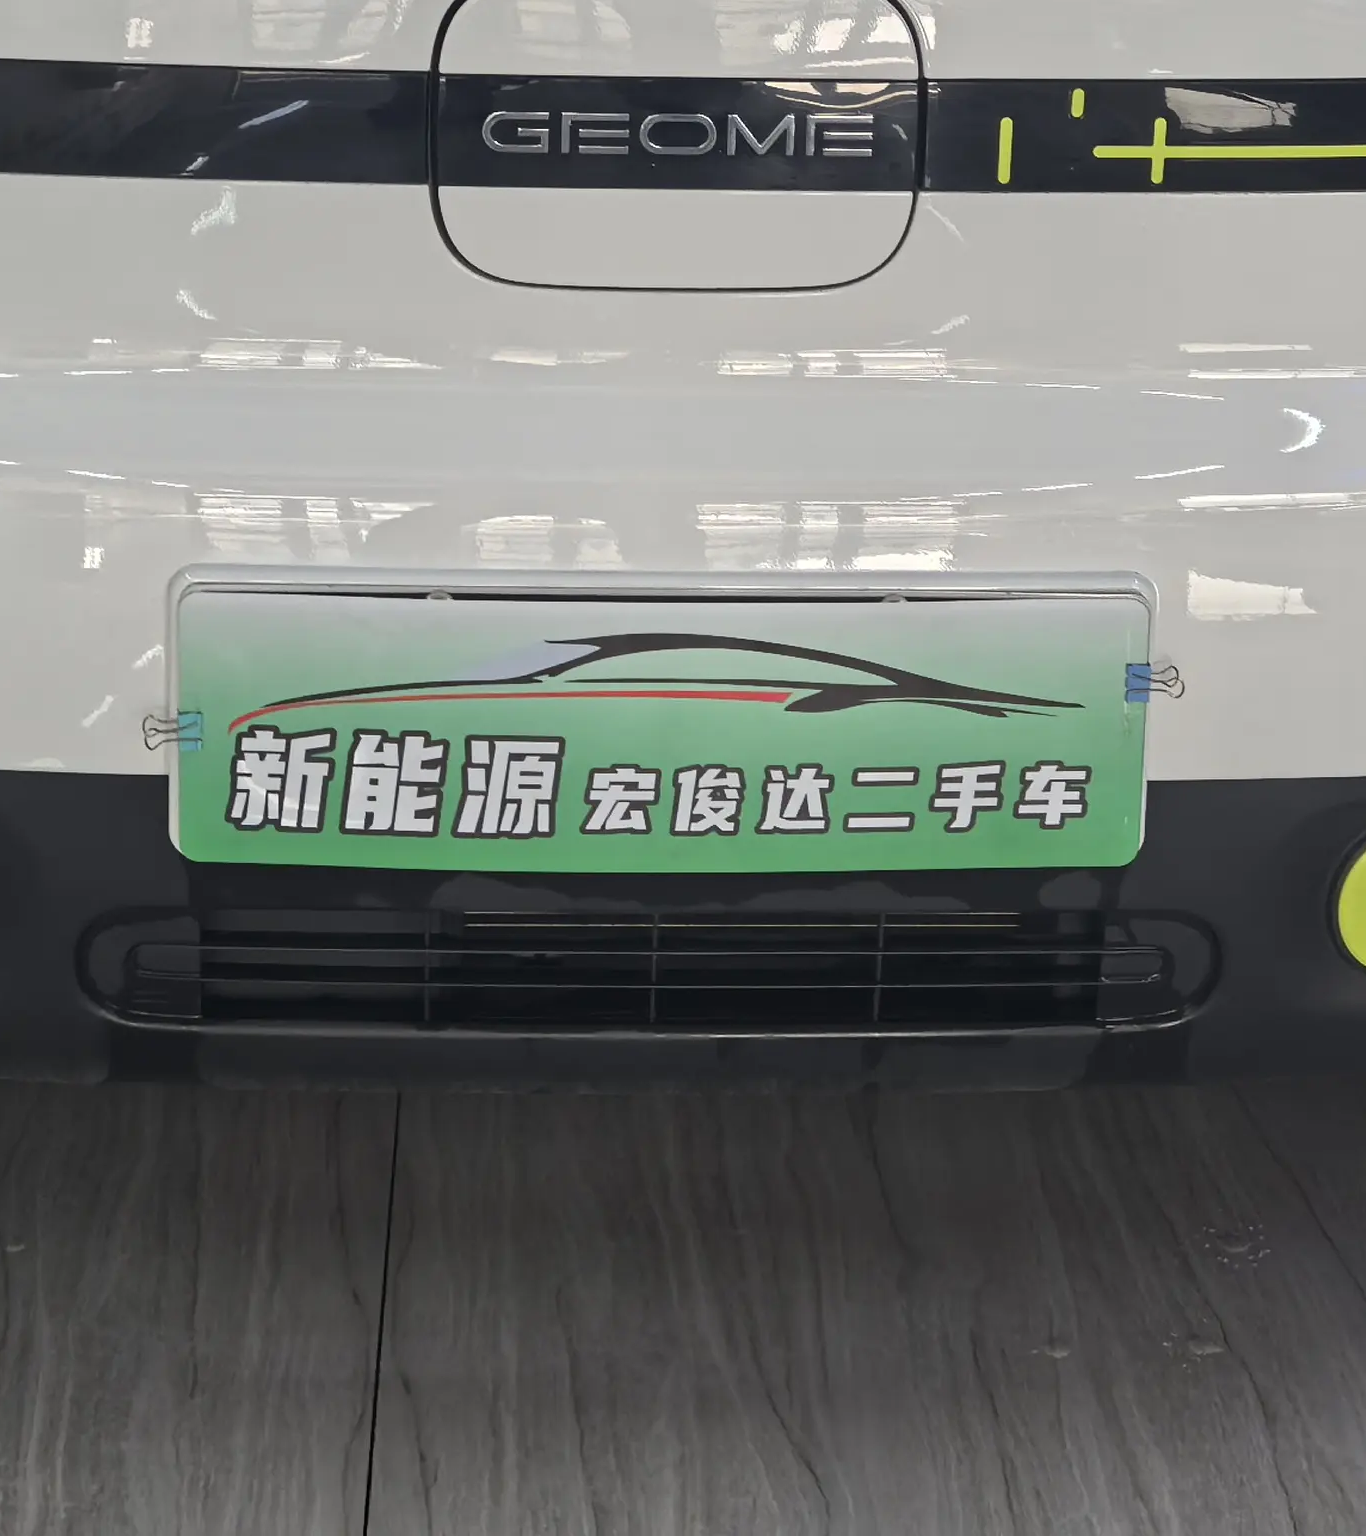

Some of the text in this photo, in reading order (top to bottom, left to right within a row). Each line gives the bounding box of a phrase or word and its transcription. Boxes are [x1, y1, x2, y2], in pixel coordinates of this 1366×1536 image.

[482, 111, 874, 157] GEOME
[232, 726, 1094, 839] 新能源 宏俊达二手车
